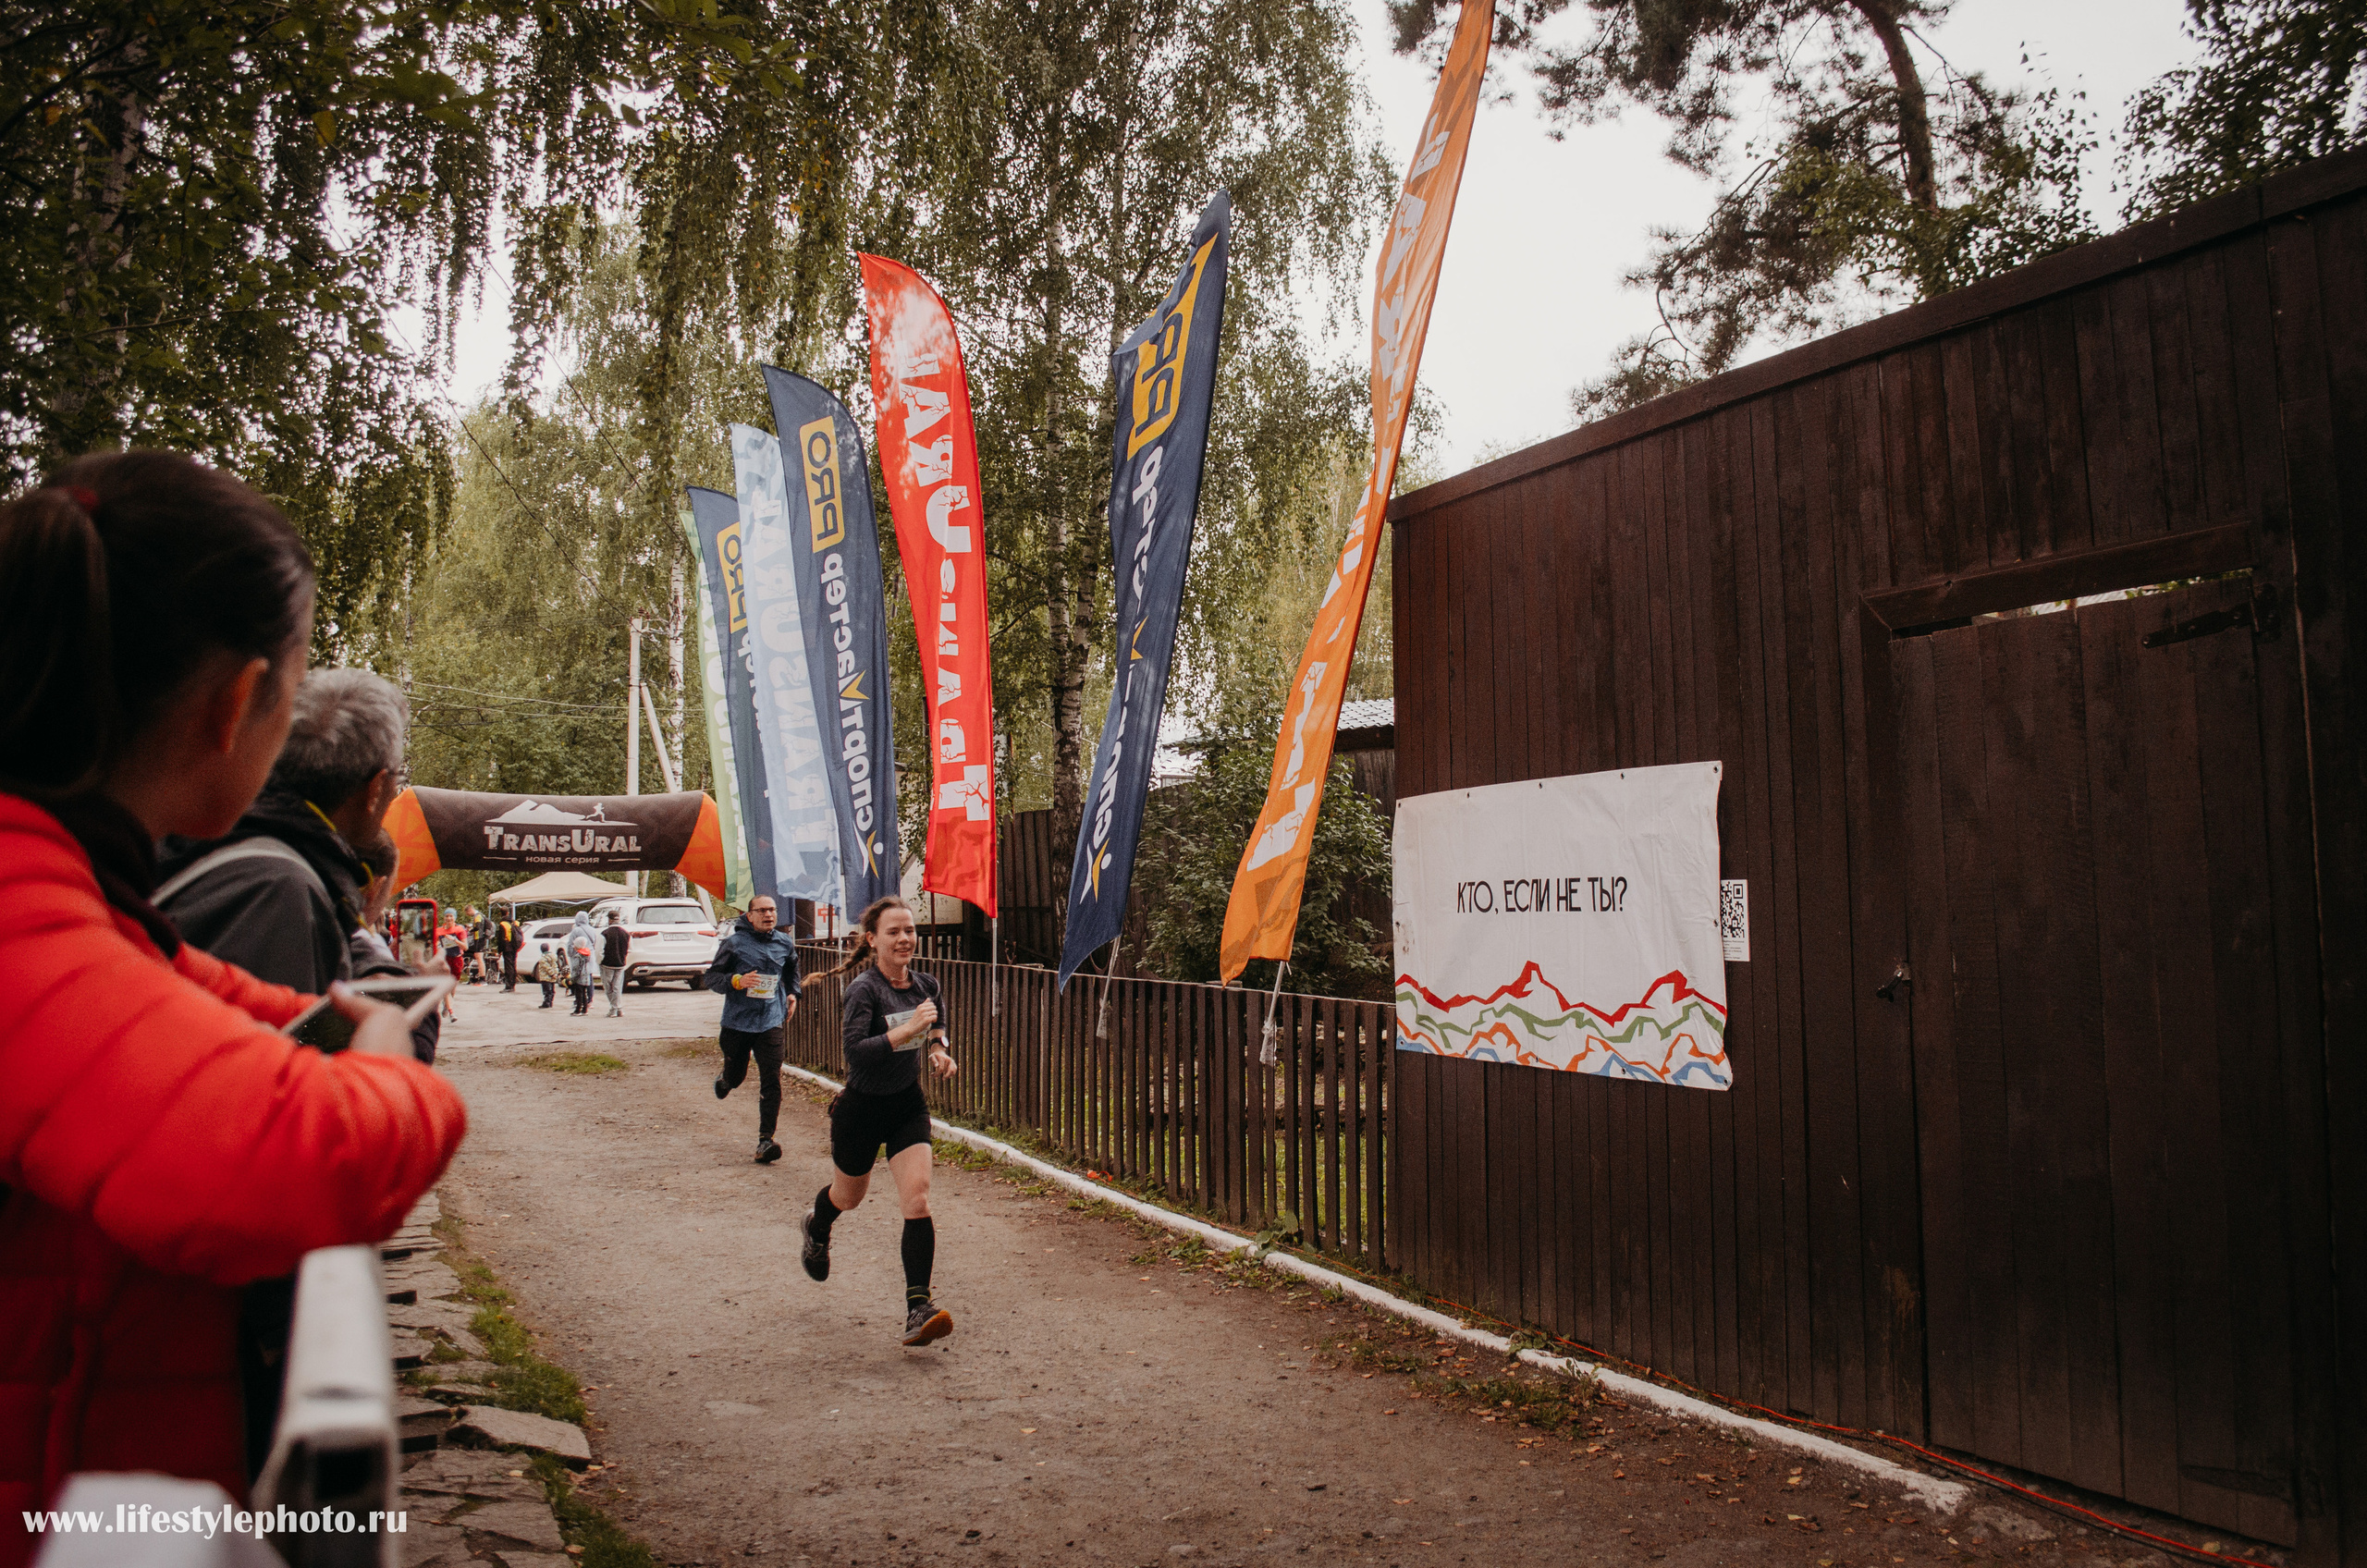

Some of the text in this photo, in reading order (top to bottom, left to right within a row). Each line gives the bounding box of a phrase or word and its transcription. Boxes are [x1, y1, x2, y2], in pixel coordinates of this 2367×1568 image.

[564, 856, 600, 865] серия
[1457, 876, 1627, 915] КТО, ЕСЛИ НЕ ТЫ?
